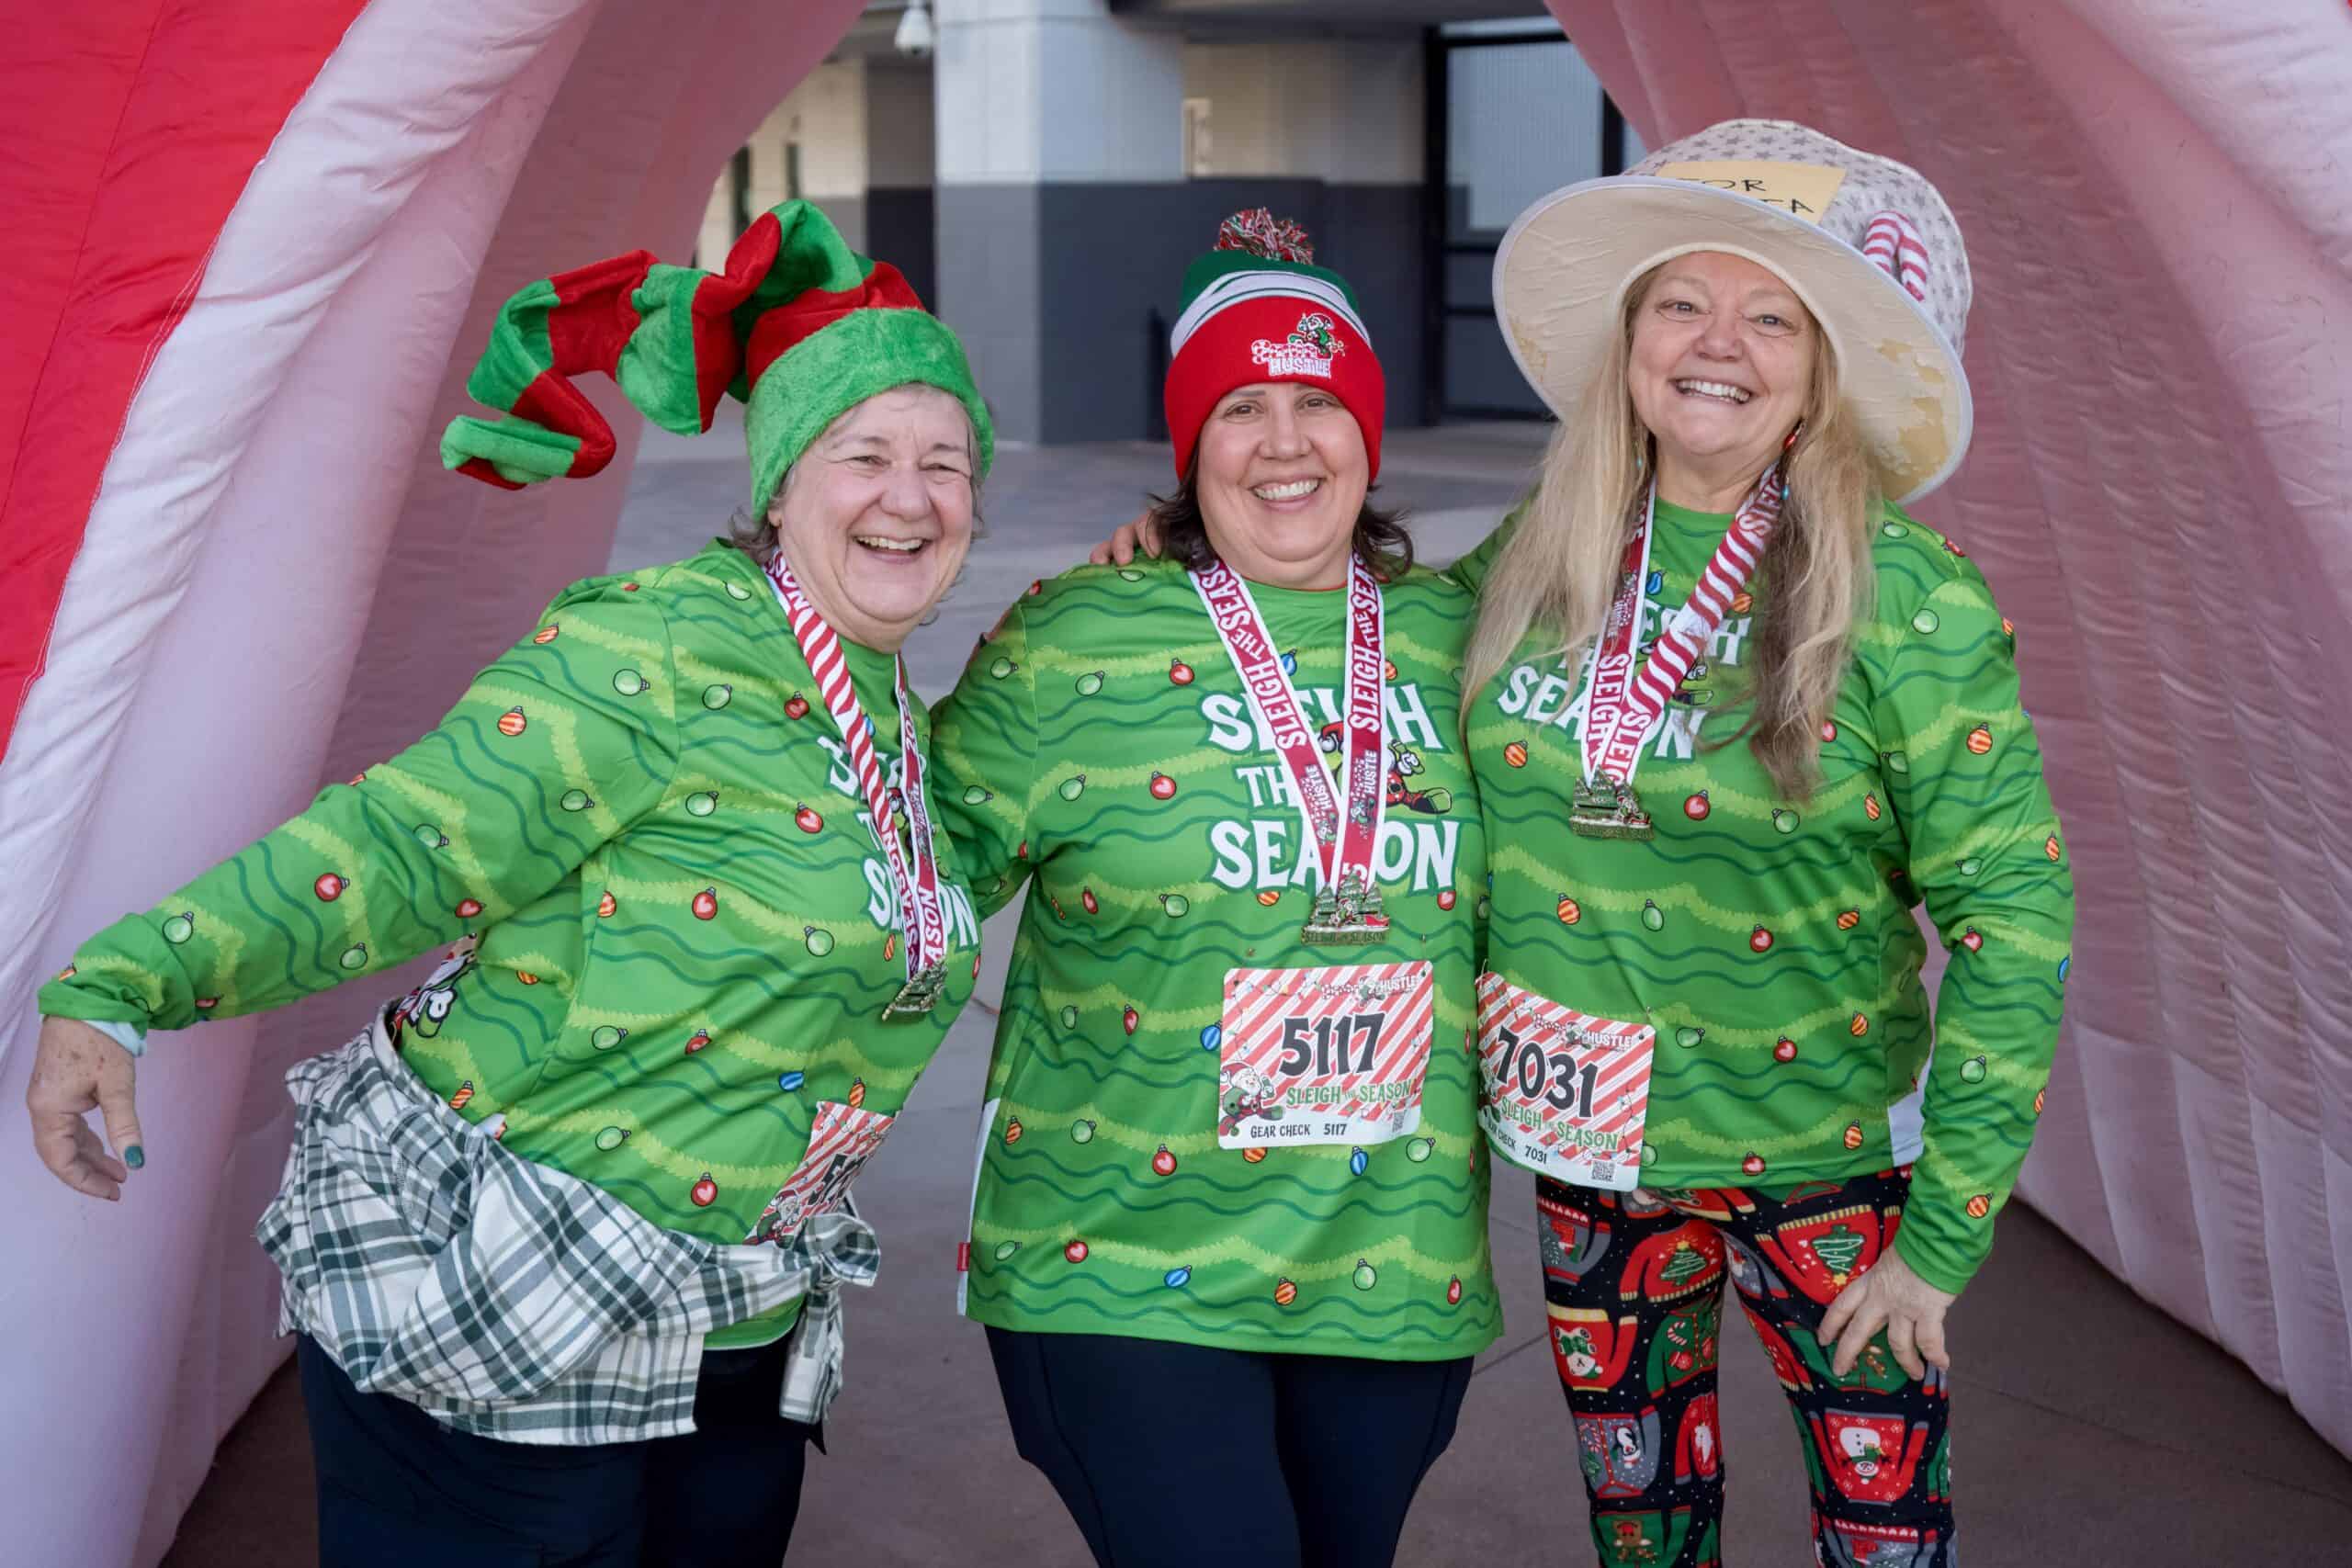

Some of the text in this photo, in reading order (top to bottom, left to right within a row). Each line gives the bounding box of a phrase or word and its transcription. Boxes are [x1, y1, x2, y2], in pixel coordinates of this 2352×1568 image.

[1355, 611, 1378, 647] THE
[1200, 558, 1307, 749] SLEIGH THE SEAS
[1351, 643, 1379, 733] SLEIGH
[1364, 750, 1377, 794] HUSTLE
[1606, 712, 1651, 788] SLEIG
[1236, 765, 1302, 808] TH
[1306, 764, 1333, 809] HUSTLE
[1211, 819, 1460, 891] SEAON
[1381, 976, 1419, 993] HUSTLE
[1279, 1012, 1385, 1077] 5117
[1586, 1030, 1632, 1047] HUSTLE
[1286, 1086, 1341, 1105] SLEIGH
[1360, 1078, 1412, 1103] SEASON
[1496, 1025, 1599, 1118] 7031
[1250, 1123, 1347, 1138] GEAR CHECK 5117
[1501, 1096, 1542, 1131] SLEIGH
[1556, 1122, 1619, 1150] SEASON
[1525, 1145, 1547, 1165] 7031
